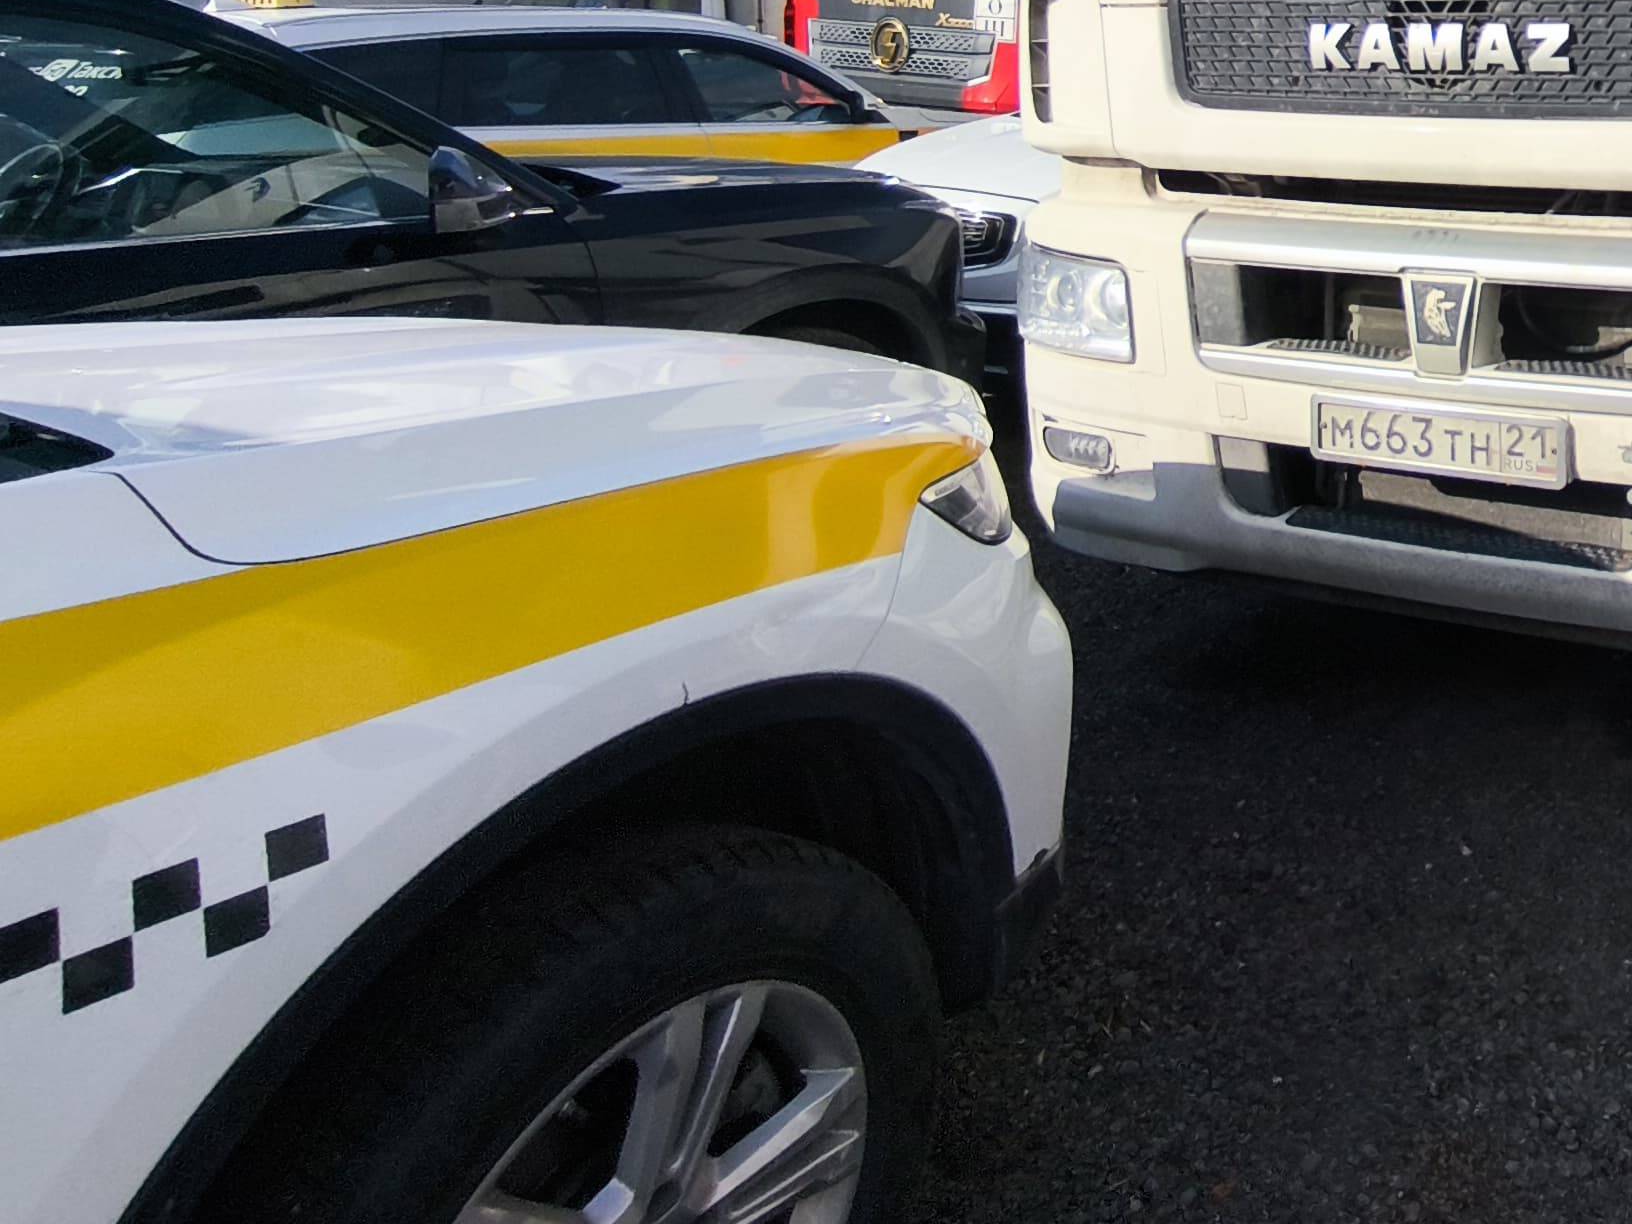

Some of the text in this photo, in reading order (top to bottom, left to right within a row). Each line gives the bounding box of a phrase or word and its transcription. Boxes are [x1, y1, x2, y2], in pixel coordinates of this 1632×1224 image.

[1308, 22, 1571, 73] KAMAZ
[1505, 424, 1549, 460] 21
[1504, 459, 1534, 473] RUS
